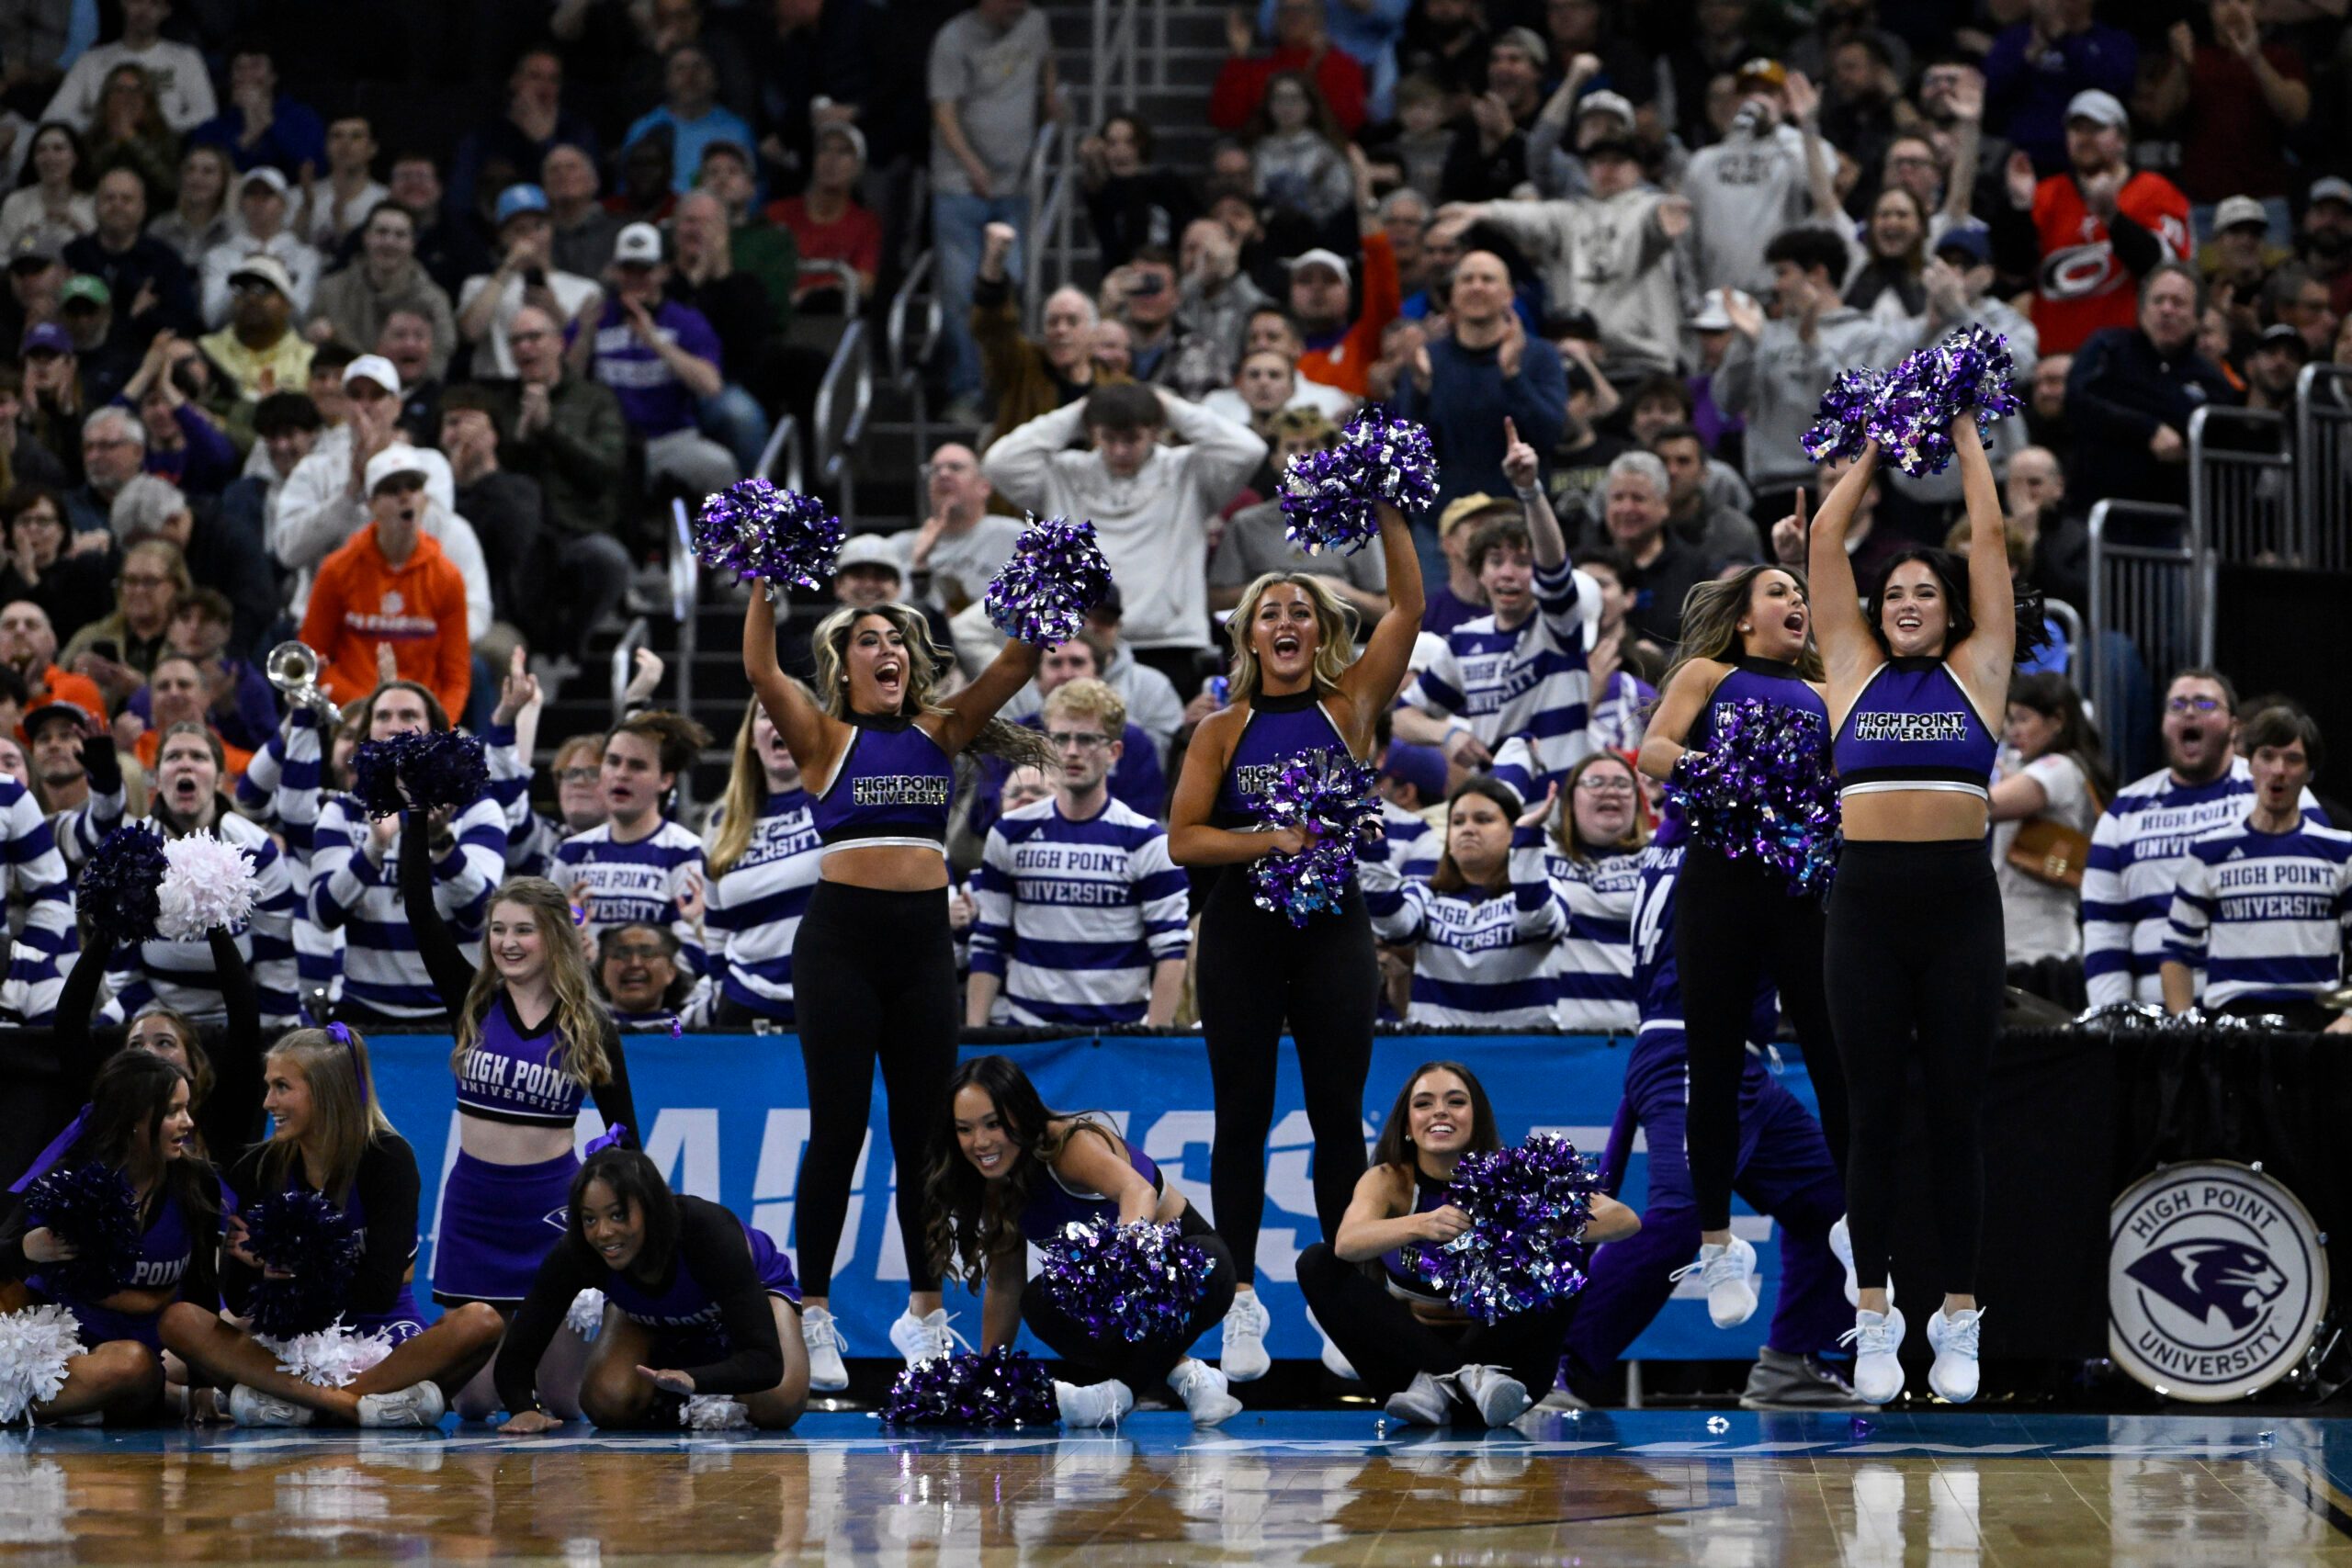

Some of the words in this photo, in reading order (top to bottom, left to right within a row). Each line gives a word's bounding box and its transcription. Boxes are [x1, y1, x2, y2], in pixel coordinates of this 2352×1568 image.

[1855, 711, 1903, 728] HIGH
[1904, 712, 1966, 728] POINT
[1854, 726, 1968, 742] UNIVERSITY
[853, 776, 899, 793] HIGH
[899, 774, 950, 793] POINT
[853, 790, 949, 806] UNIVERSITY
[1015, 849, 1062, 870] HIGH
[1067, 851, 1130, 874] POINT
[611, 870, 663, 891] POINT
[2220, 865, 2267, 888] HIGH
[2274, 863, 2334, 886] POINT
[461, 1048, 510, 1087] HIGH
[511, 1059, 579, 1102] POINT
[461, 1078, 571, 1111] UNIVERSITY
[2131, 1189, 2192, 1240] HIGH
[2203, 1186, 2278, 1231] POINT
[2139, 1325, 2282, 1376] UNIVERSITY
